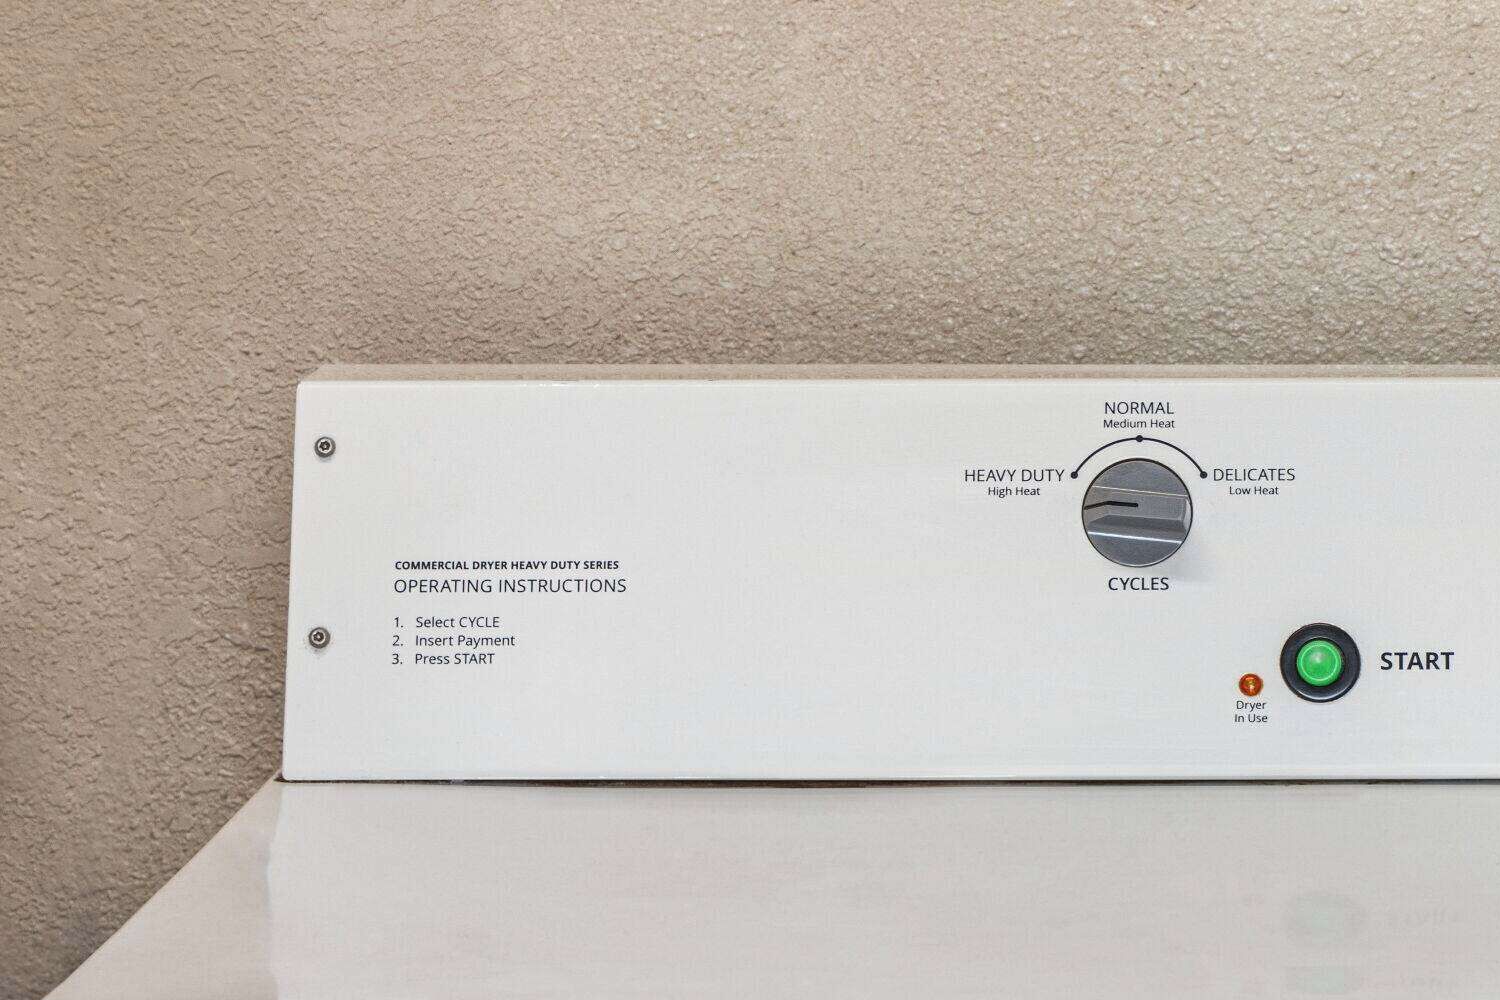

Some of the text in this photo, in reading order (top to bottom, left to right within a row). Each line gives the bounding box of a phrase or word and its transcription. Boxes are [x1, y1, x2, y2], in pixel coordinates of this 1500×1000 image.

[1104, 400, 1175, 415] NORMAL
[1103, 418, 1176, 429] Medium Heat
[964, 468, 1065, 483] HEAVY DUTY
[1213, 467, 1296, 482] DELICATES
[987, 485, 1041, 499] High Heat
[1229, 485, 1280, 496] Low Heat
[394, 560, 620, 571] COMMERCIAL DRYER HEAVY DUTY SERIES
[393, 578, 627, 594] OPERATING INSTRUCTIONS
[1107, 575, 1170, 591] CYCLES
[393, 615, 500, 629] 1. Select CYCLE
[392, 634, 516, 650] 2. Insert Payment
[391, 652, 496, 665] 3. Press START
[1380, 651, 1455, 671] START
[1235, 700, 1267, 713] Dryer
[1234, 713, 1268, 723] In Use
